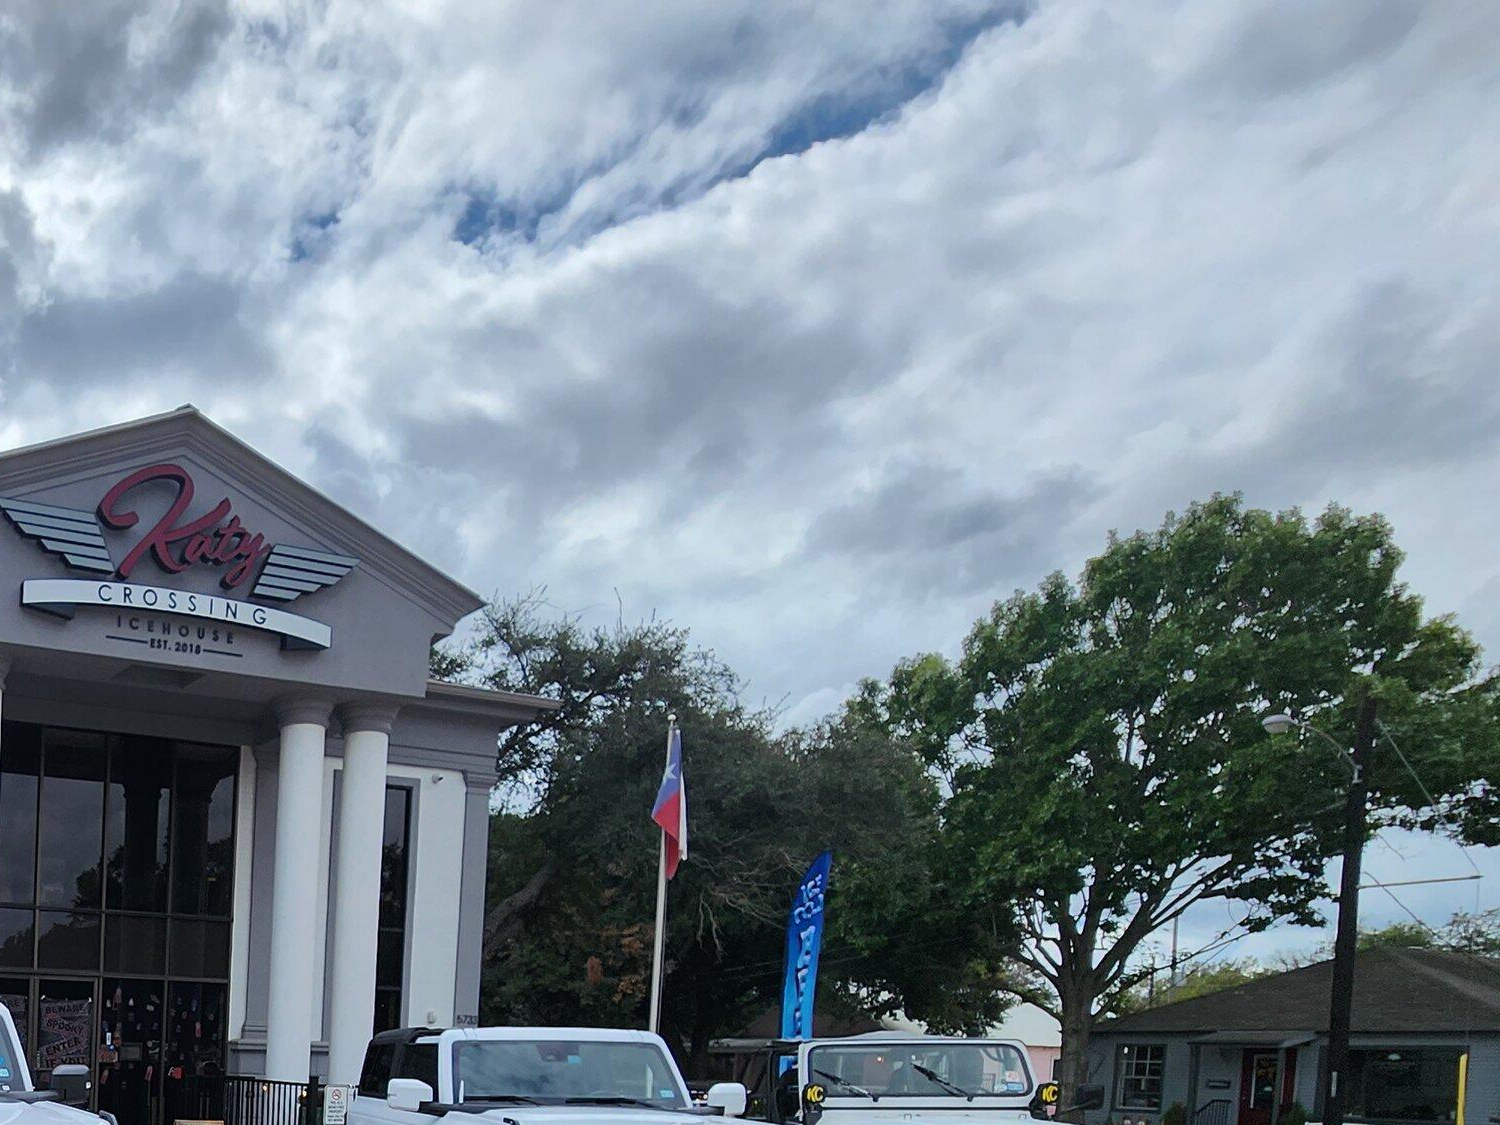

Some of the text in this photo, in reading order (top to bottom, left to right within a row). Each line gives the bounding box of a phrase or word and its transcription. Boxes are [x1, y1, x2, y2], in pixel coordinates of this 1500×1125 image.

[97, 463, 272, 589] Katy
[98, 584, 267, 625] CROSSING
[117, 615, 234, 644] ICEHOUSE
[149, 638, 201, 655] EST. 2018
[807, 1085, 823, 1102] KC
[1043, 1086, 1058, 1102] KC
